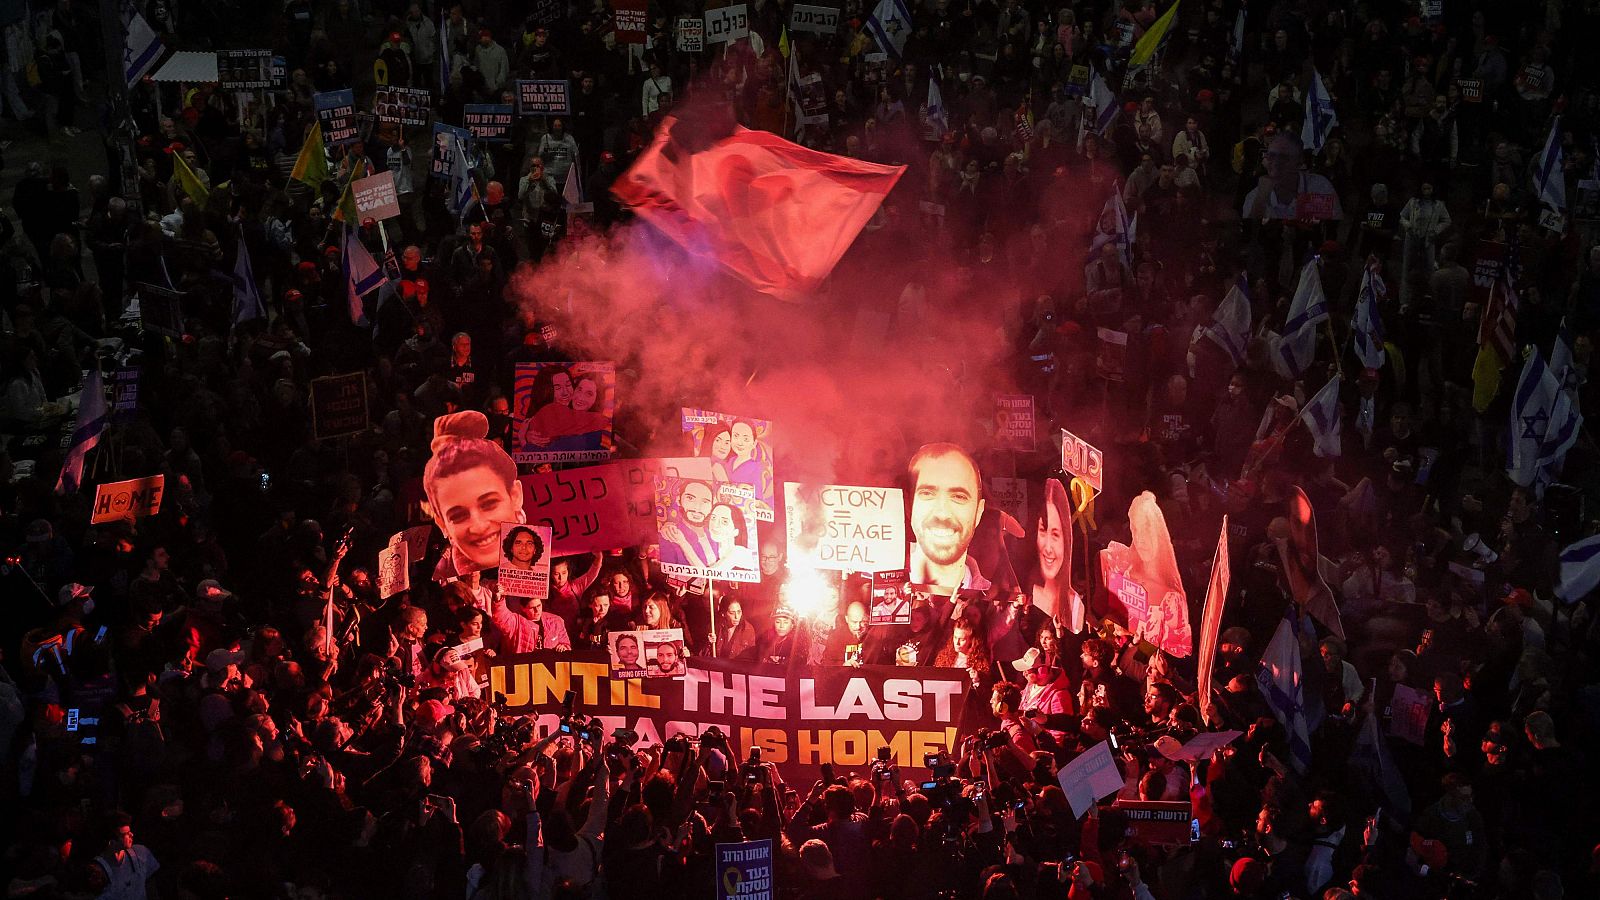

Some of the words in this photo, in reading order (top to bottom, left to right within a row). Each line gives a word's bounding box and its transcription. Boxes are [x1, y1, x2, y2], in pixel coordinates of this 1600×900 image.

[794, 11, 837, 26] הביתה
[616, 22, 646, 32] WAR
[522, 84, 538, 93] את
[540, 83, 564, 93] עצרו
[522, 92, 565, 103] המלחמה
[321, 109, 333, 119] דם
[334, 106, 353, 117] כמה
[331, 119, 346, 129] עוד
[465, 114, 480, 124] עוד
[482, 114, 494, 124] דם
[494, 114, 512, 124] כמה
[357, 195, 394, 212] WAR
[553, 452, 576, 461] אותה
[579, 451, 609, 462] החזירו
[530, 473, 608, 508] כולנו
[756, 510, 773, 520] החז
[539, 512, 601, 541] עינב
[820, 544, 876, 564] DEAL
[702, 569, 723, 577] אותו
[491, 662, 661, 709] UNTIL
[673, 667, 786, 720] THE
[800, 678, 962, 722] LAST
[739, 727, 788, 764] IS
[722, 850, 743, 862] הרוב
[746, 847, 769, 861] אנחנו
[746, 866, 770, 880] בעד
[736, 878, 770, 894] עסקת
